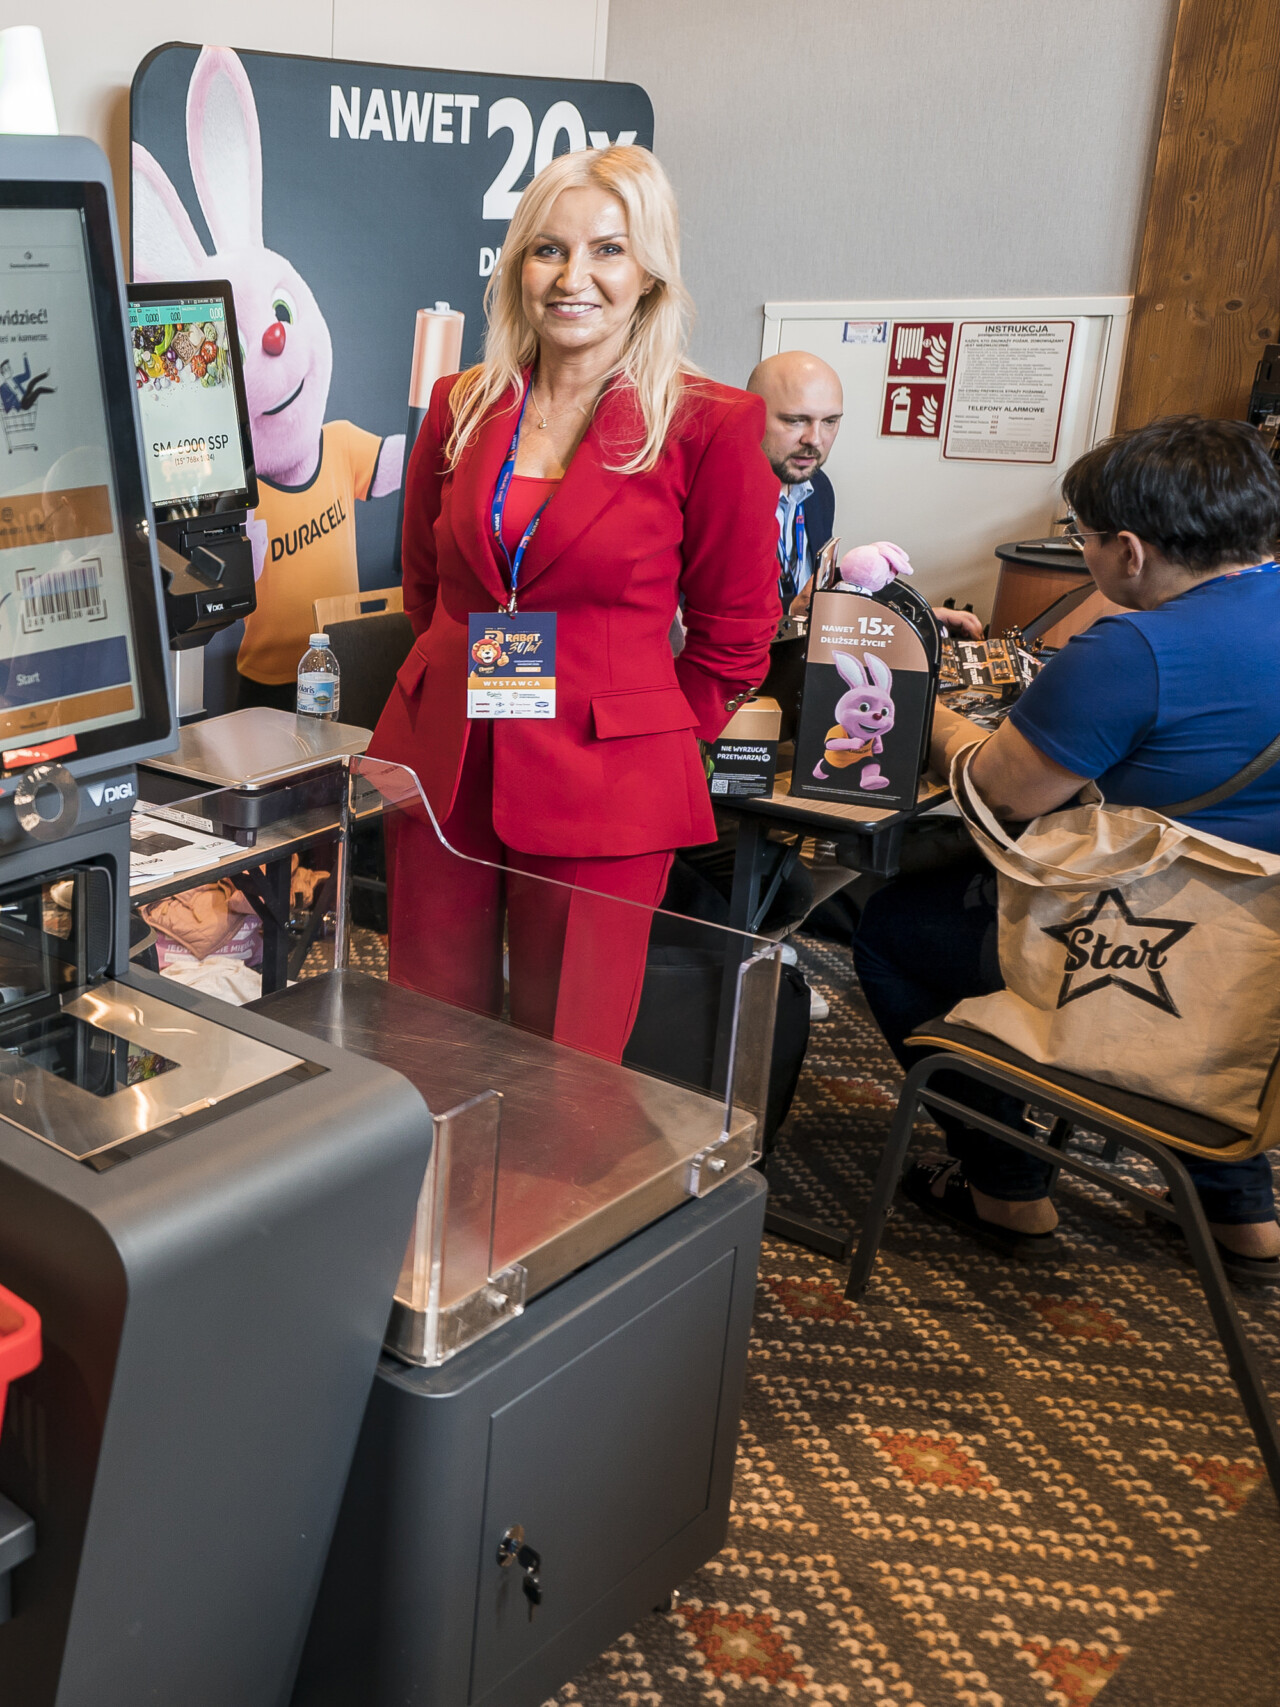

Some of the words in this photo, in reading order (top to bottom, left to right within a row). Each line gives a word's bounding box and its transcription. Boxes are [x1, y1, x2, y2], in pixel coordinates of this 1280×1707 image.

[329, 84, 480, 144] NAWET
[482, 97, 638, 220] 20
[984, 325, 1049, 333] INSTRUKCJA
[207, 434, 229, 451] SSP
[271, 499, 346, 562] DURACELL
[821, 624, 855, 633] NAWET
[857, 616, 895, 637] 15x
[505, 633, 541, 642] RABAT
[820, 635, 859, 646] DŁUŻSZE
[16, 671, 40, 687] Start
[717, 753, 762, 762] PRZETWARZAJ
[1063, 927, 1167, 973] Star
